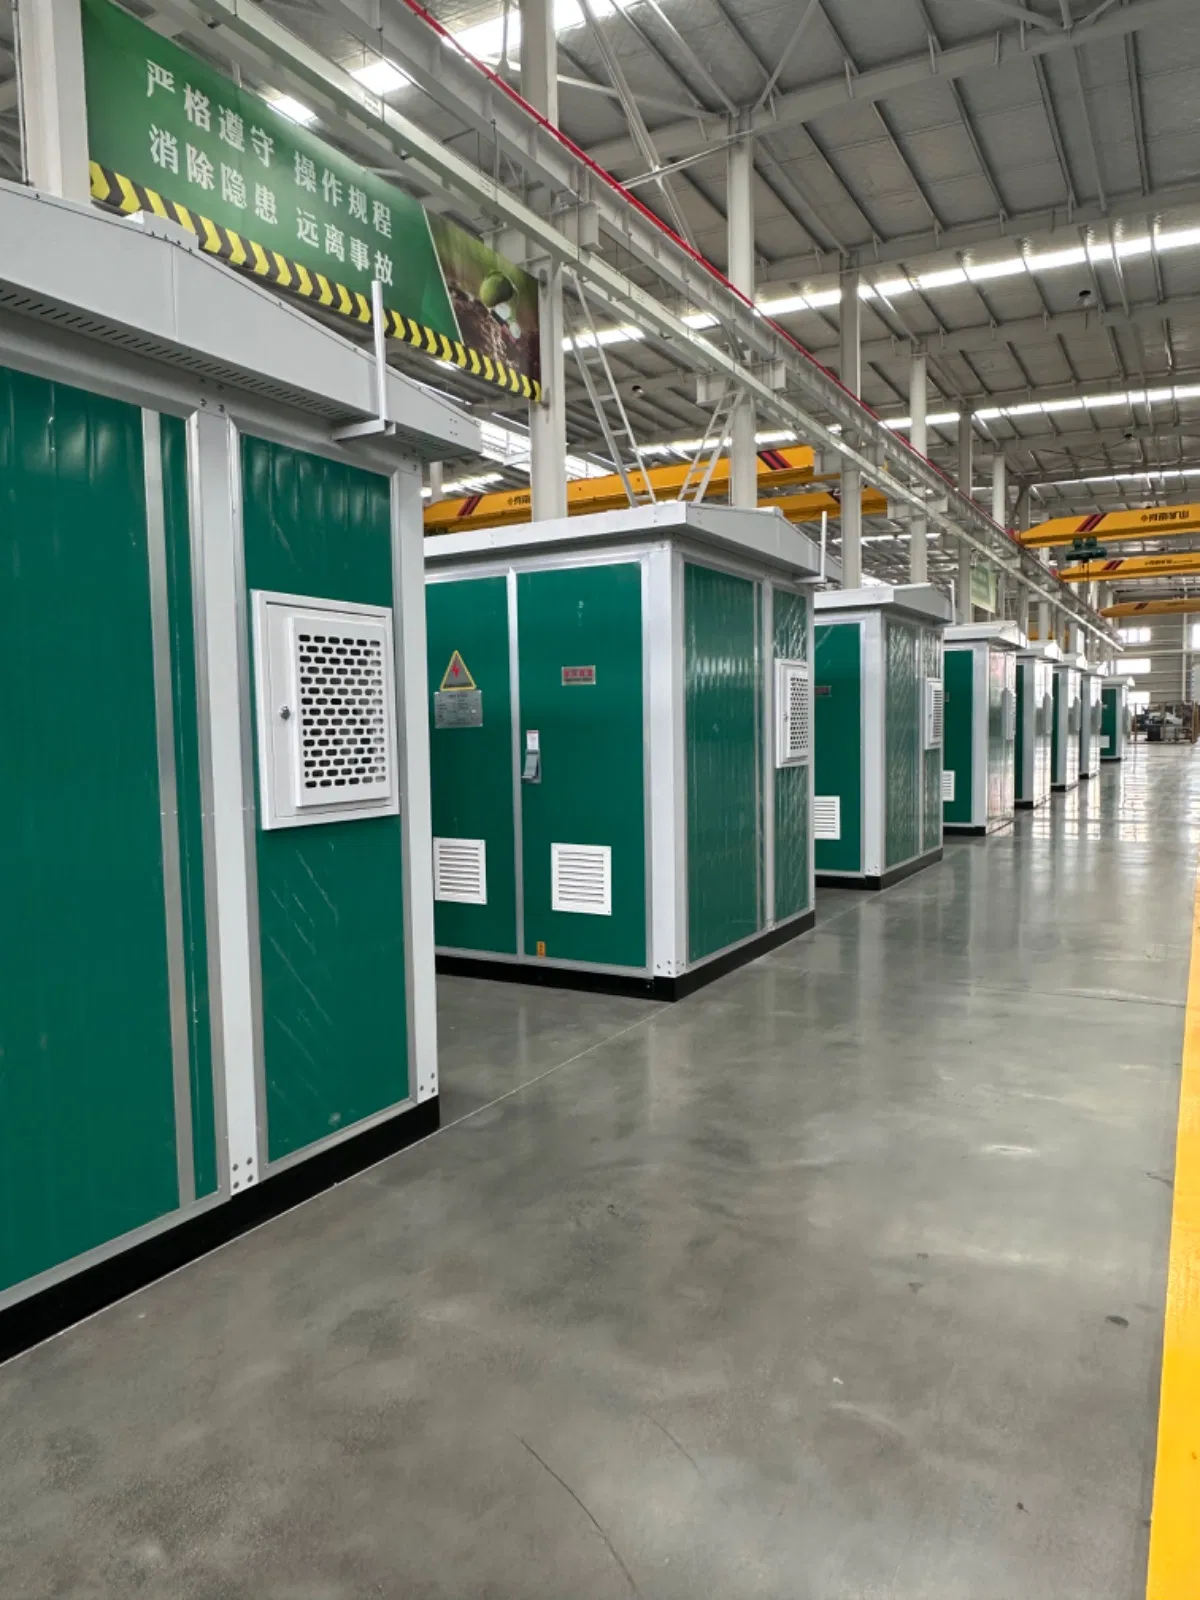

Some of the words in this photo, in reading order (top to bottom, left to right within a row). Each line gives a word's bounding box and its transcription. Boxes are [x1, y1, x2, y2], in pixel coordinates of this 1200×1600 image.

[146, 60, 274, 167] 严格遵守
[293, 150, 393, 240] 操作规程
[148, 123, 279, 225] 消除隐患
[295, 207, 394, 287] 远离事故
